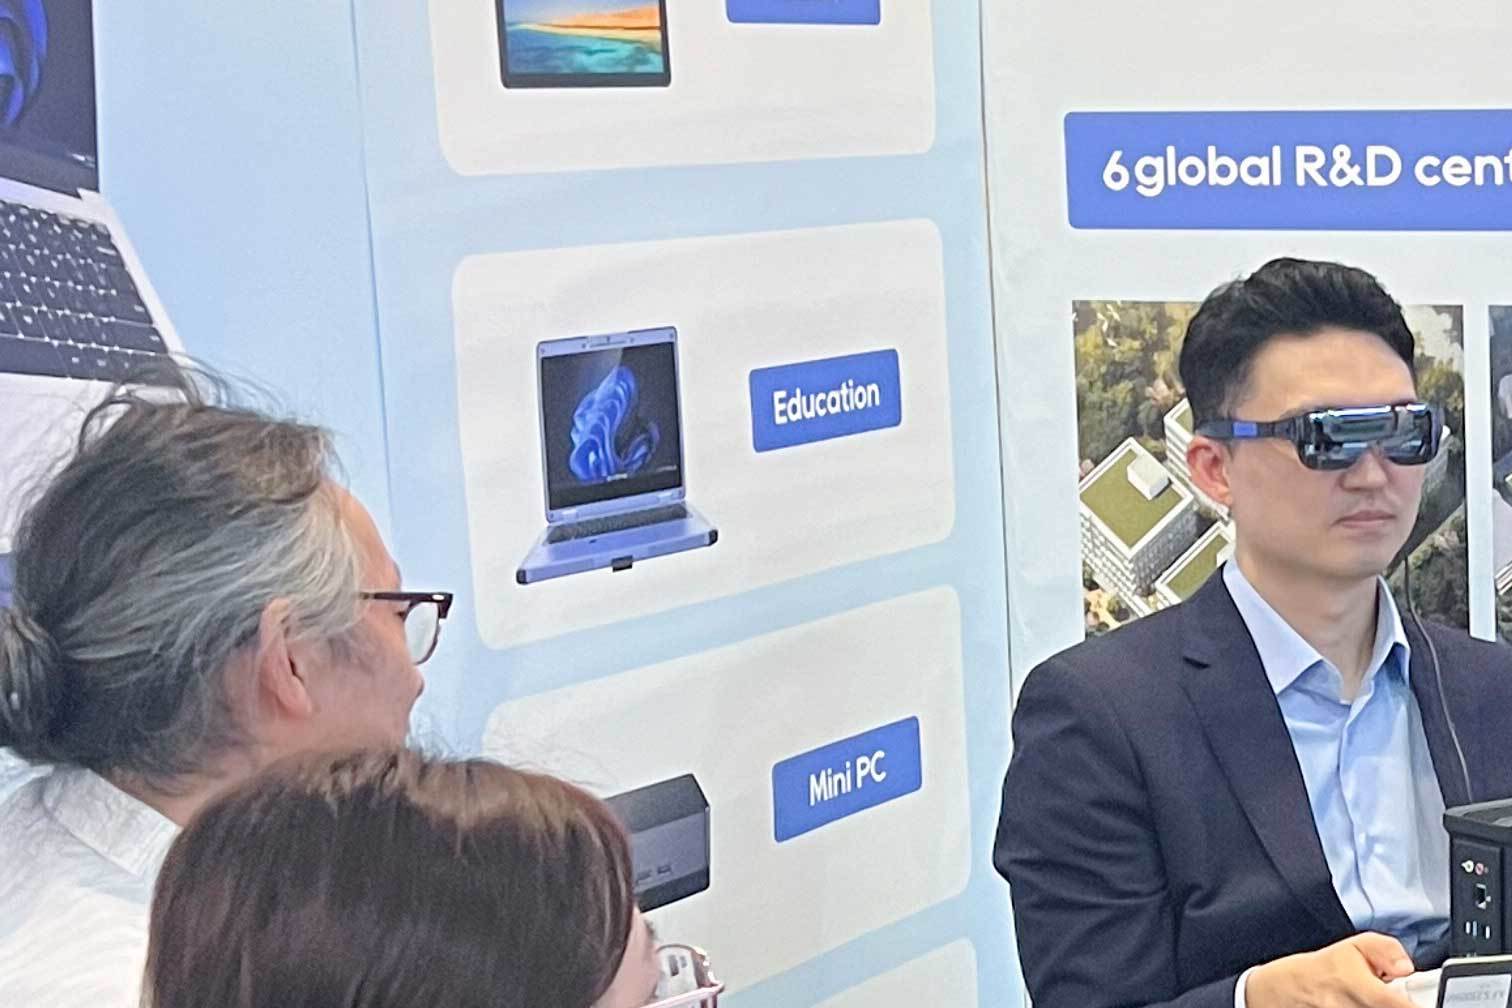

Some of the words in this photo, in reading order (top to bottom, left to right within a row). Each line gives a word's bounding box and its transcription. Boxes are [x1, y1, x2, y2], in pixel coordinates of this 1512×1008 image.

[1295, 144, 1402, 187] R&D
[773, 379, 880, 425] Education
[809, 760, 851, 806] Mini
[856, 750, 886, 788] PC
